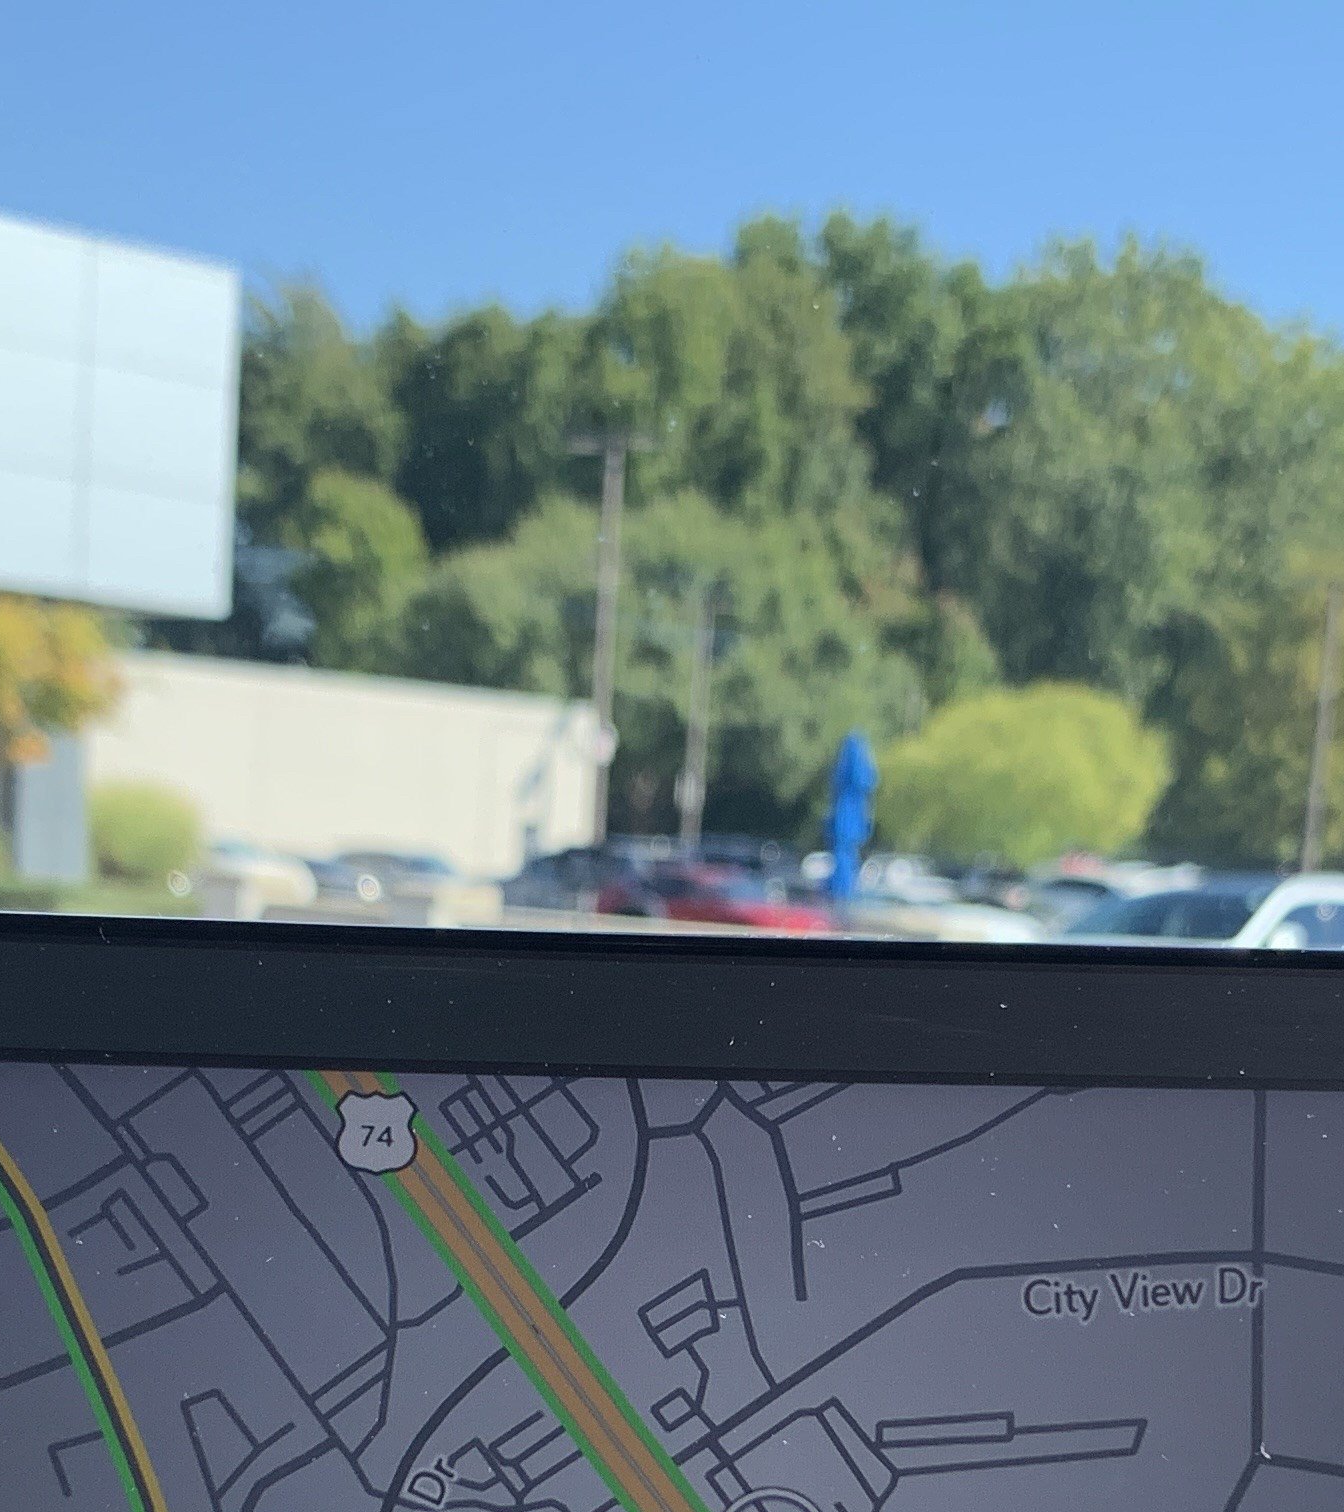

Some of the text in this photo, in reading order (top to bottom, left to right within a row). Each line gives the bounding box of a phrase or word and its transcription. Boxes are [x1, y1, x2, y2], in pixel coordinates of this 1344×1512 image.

[360, 1124, 394, 1148] 74
[1022, 1266, 1263, 1322] City View Dr
[407, 1457, 456, 1506] Dr
